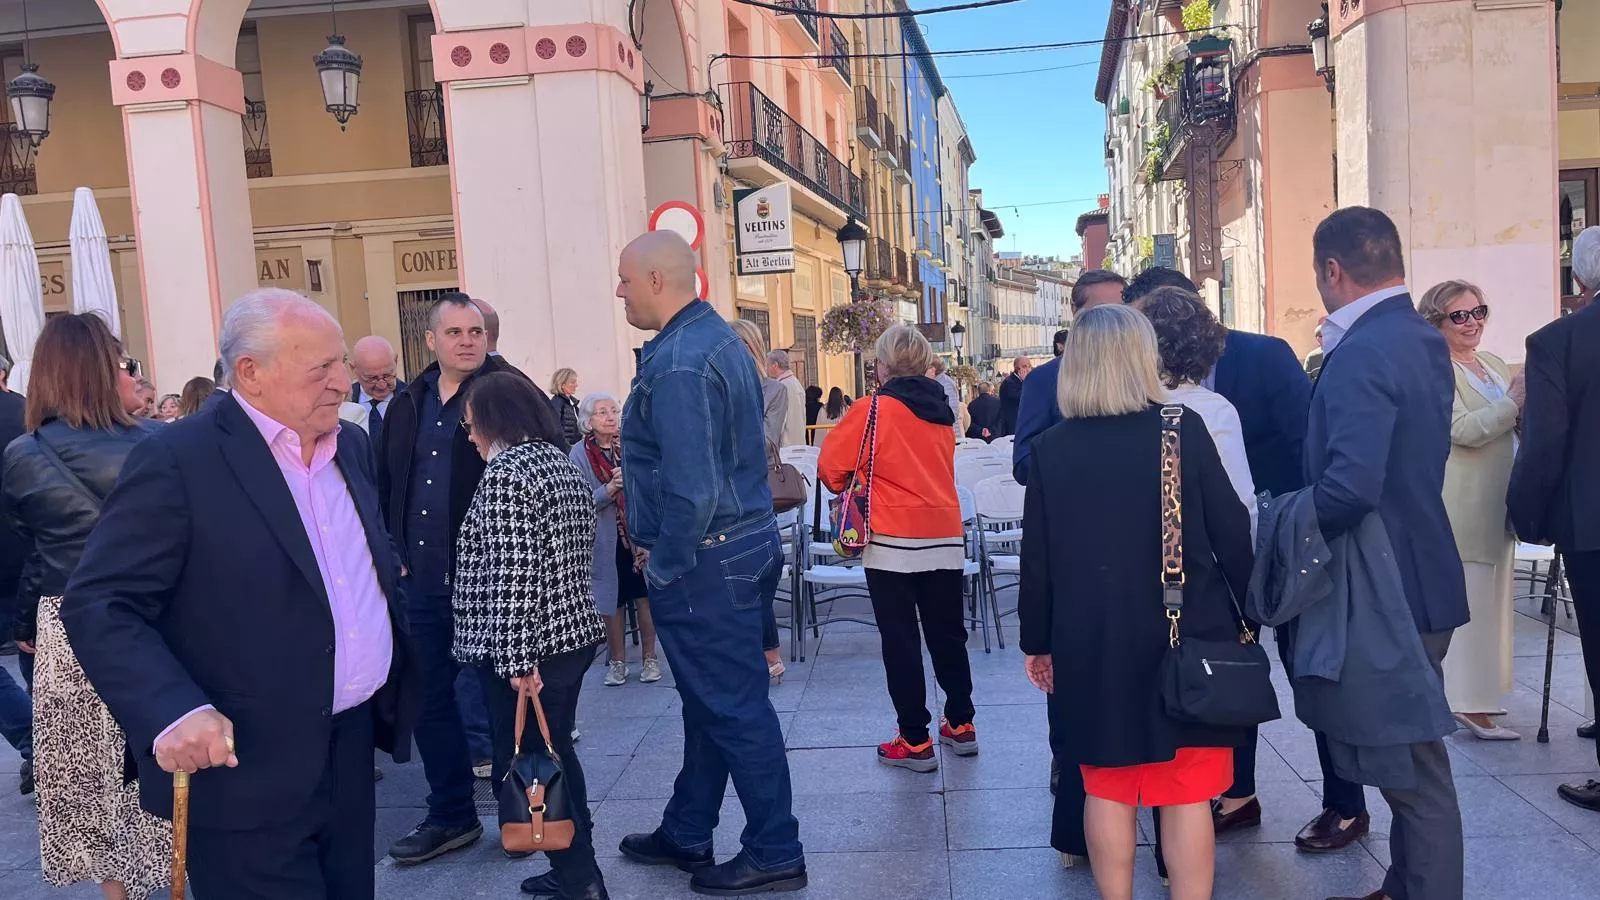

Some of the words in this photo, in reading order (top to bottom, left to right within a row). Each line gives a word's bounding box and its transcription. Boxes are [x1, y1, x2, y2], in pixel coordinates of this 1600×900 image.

[745, 220, 785, 232] VELTINS
[260, 258, 290, 280] AN
[402, 249, 458, 272] CONFE
[745, 258, 759, 268] Alt
[762, 256, 791, 267] Berlin
